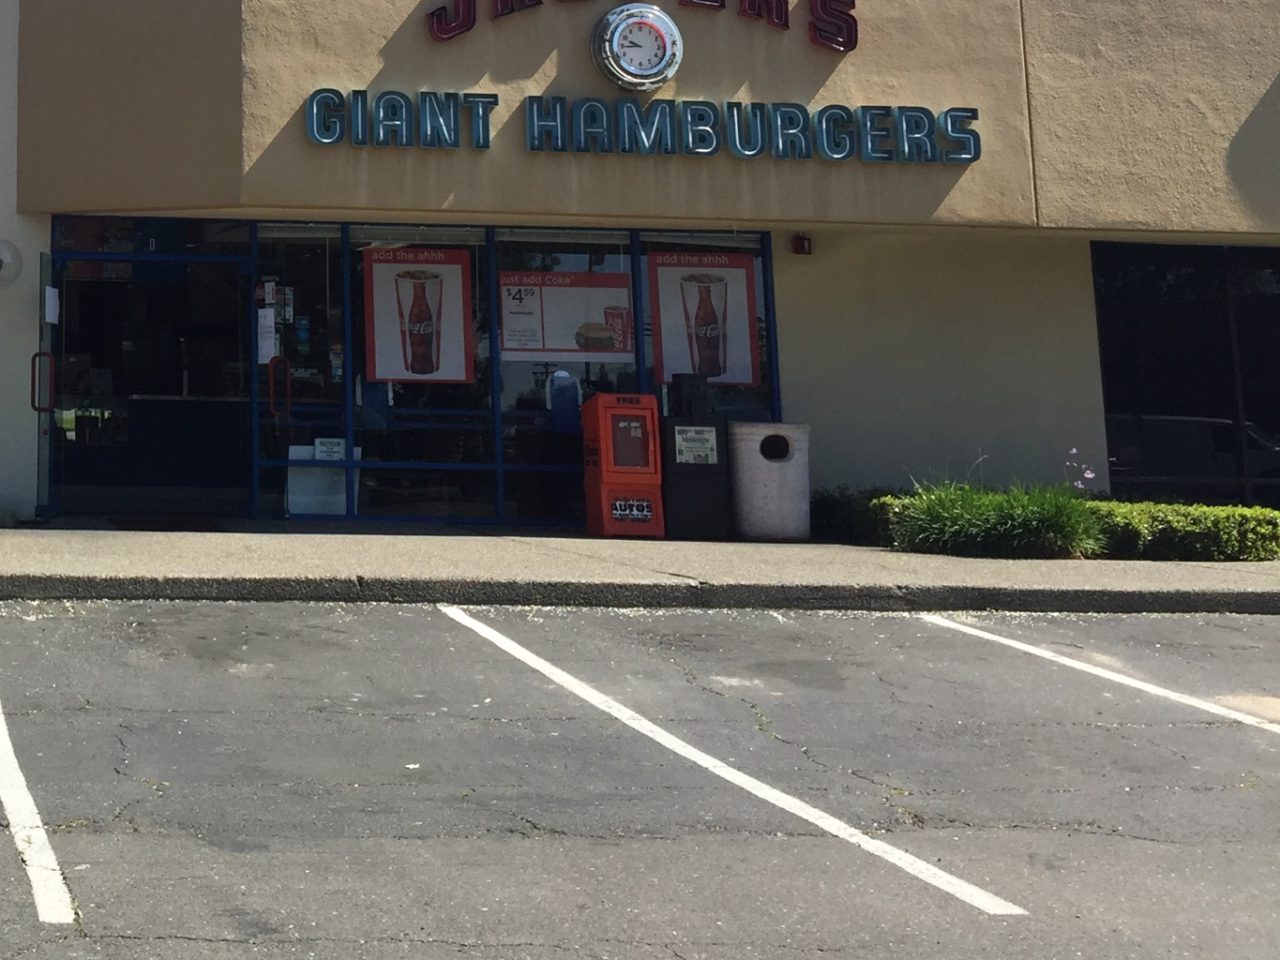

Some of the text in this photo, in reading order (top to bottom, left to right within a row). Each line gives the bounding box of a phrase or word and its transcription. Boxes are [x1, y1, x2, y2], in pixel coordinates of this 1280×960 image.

[305, 87, 983, 165] GIANT HAMBURGERS
[371, 249, 445, 261] add the ahhh
[655, 254, 728, 265] add the ahhh
[521, 275, 542, 285] add
